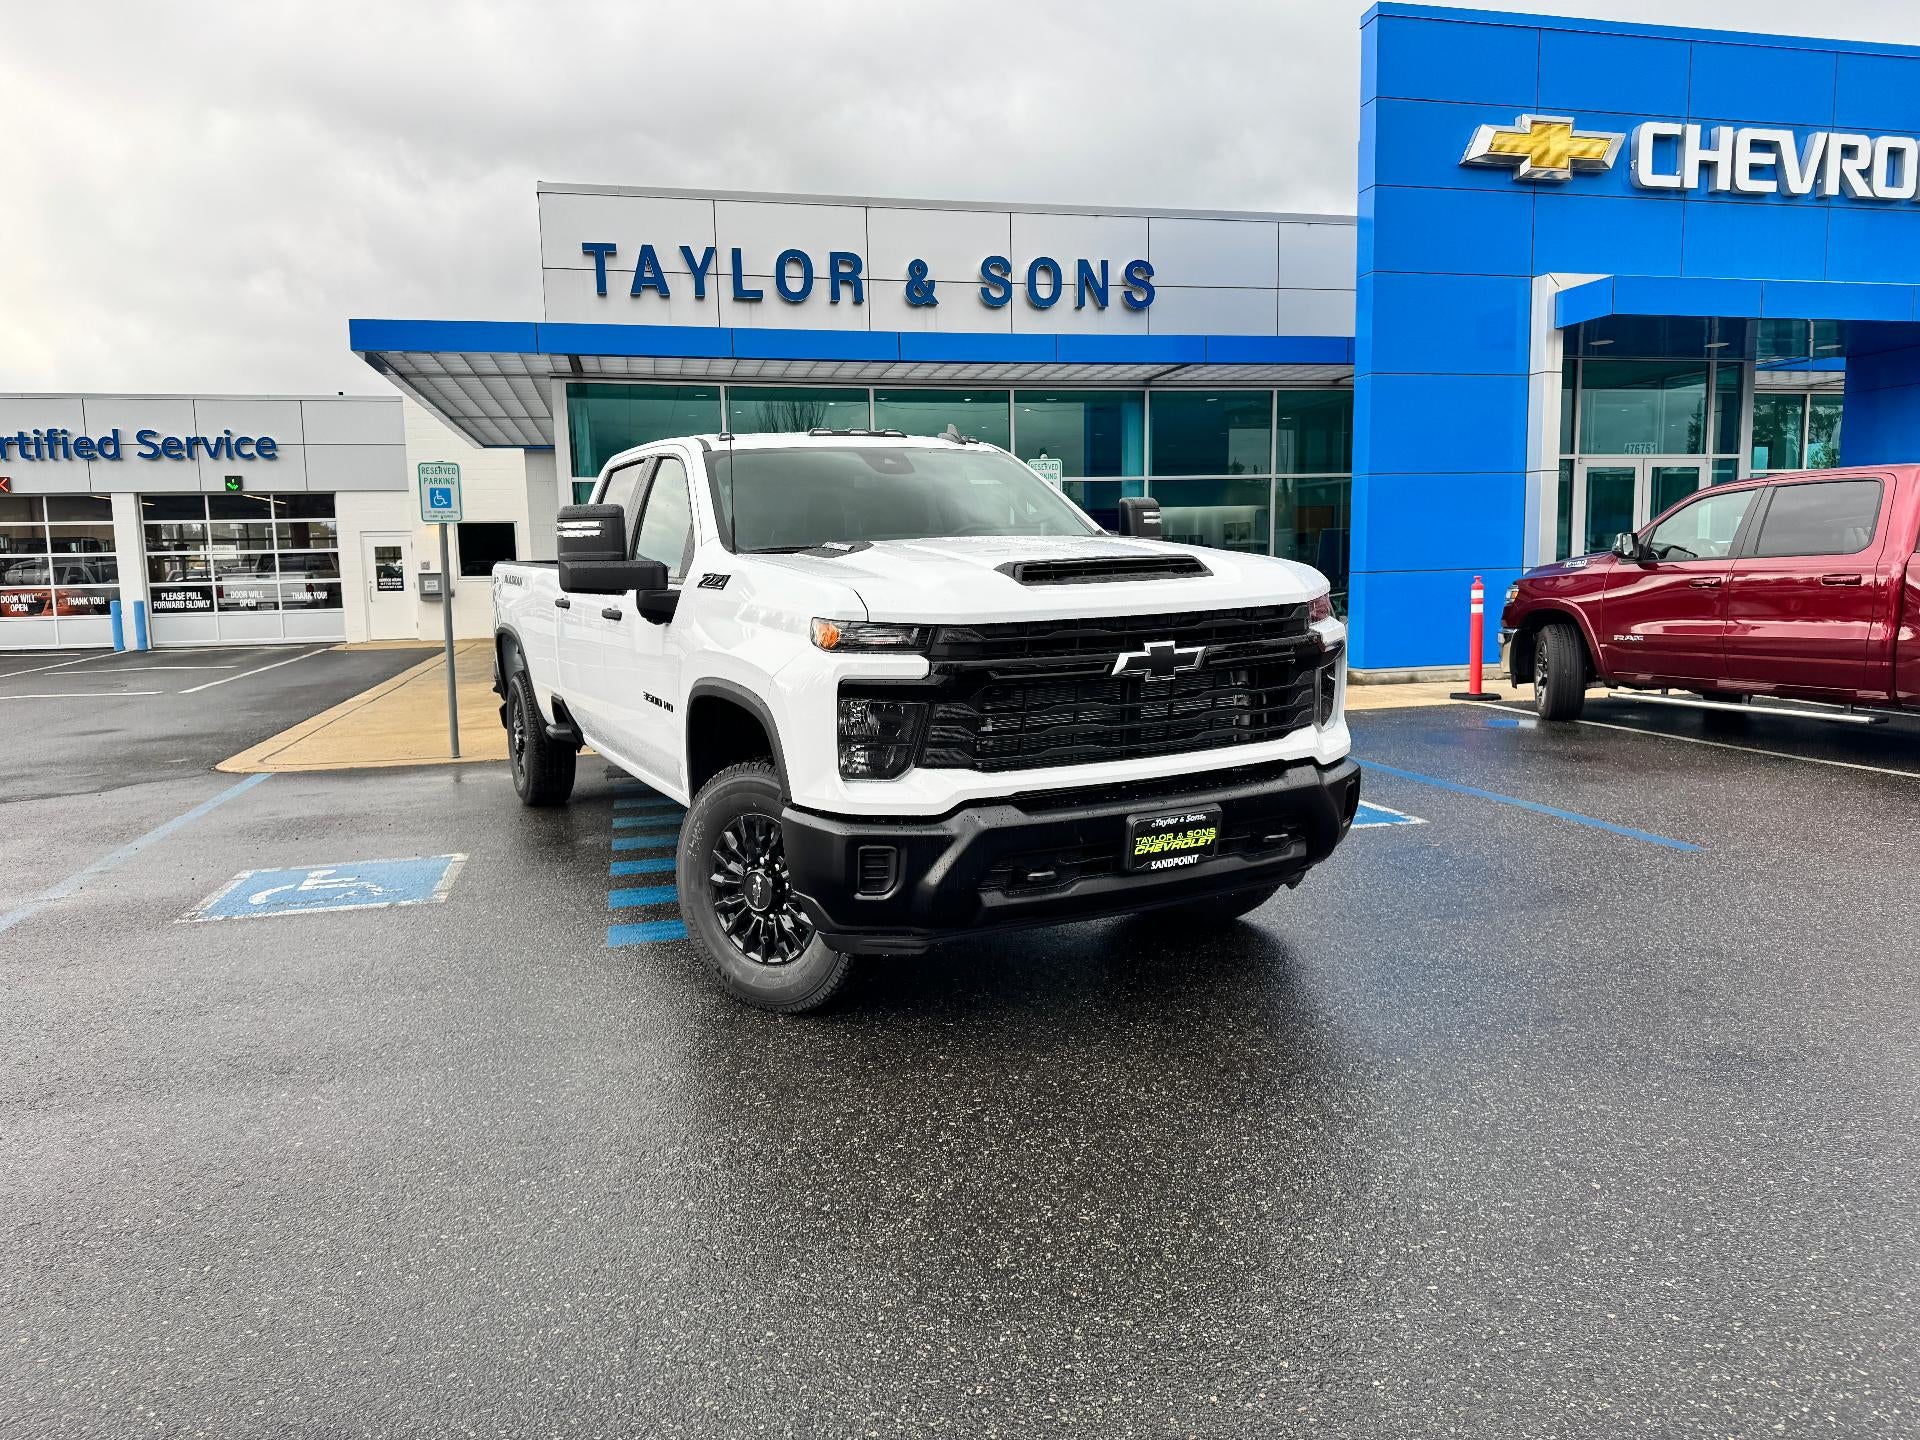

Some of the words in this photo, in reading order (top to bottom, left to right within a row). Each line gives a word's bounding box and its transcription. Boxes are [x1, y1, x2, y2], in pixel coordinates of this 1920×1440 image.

[1630, 121, 1920, 199] CHEVRO
[581, 242, 866, 306] TAYLOR
[905, 257, 940, 306] &
[979, 255, 1157, 311] SONS
[0, 428, 122, 461] rtified
[135, 428, 279, 461] Service
[421, 466, 456, 475] RESERVED
[423, 477, 455, 485] PARKING
[0, 595, 19, 604] DOOR
[20, 593, 37, 603] WILL
[161, 592, 186, 600] PLEASE
[187, 591, 202, 600] PULL
[230, 591, 249, 599] DOOR
[249, 590, 264, 598] WILL
[291, 592, 312, 600] THANK
[313, 591, 328, 600] YOU!
[66, 597, 89, 606] THANK
[89, 596, 106, 605] YOU!
[153, 600, 184, 609] FORWARD
[186, 599, 211, 608] SLOWLY
[239, 599, 256, 607] OPEN
[10, 603, 29, 612] OPEN
[1155, 818, 1178, 827] Taylor
[1186, 814, 1202, 823] Sons
[1135, 832, 1174, 845] TAYLOR
[1176, 832, 1184, 841] &
[1186, 827, 1216, 838] SONS
[1134, 835, 1216, 856] CHEVROLET
[1151, 854, 1200, 869] SANDPOINT
